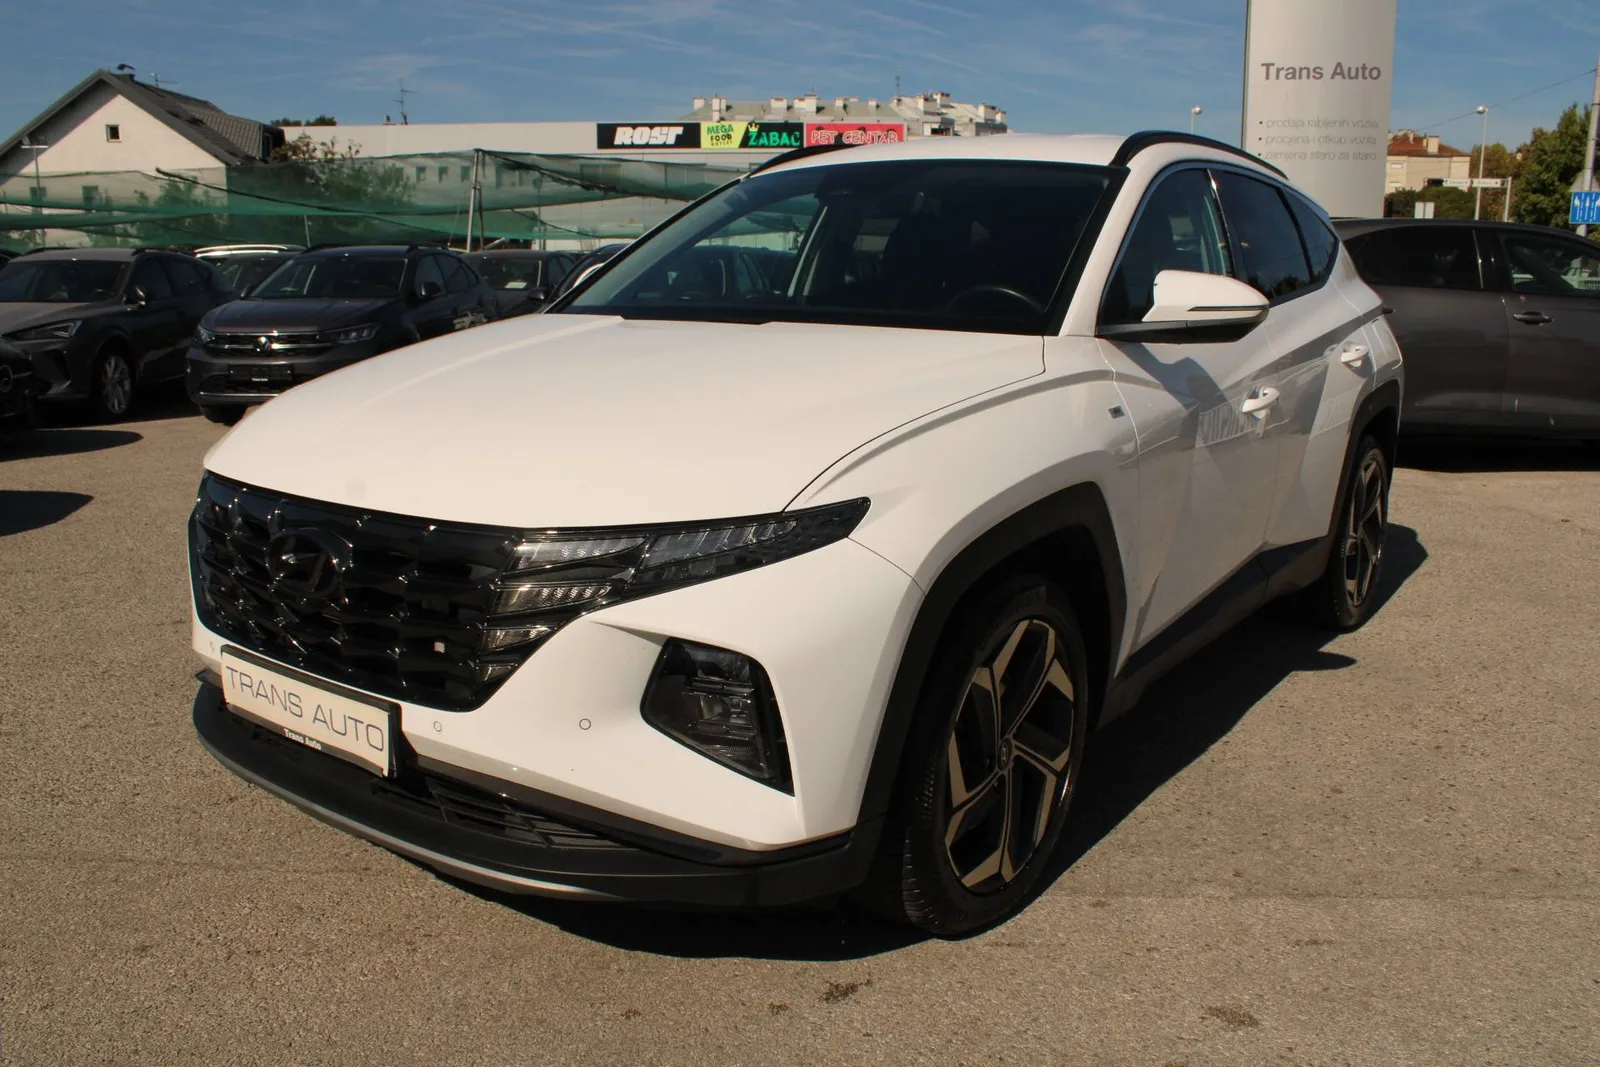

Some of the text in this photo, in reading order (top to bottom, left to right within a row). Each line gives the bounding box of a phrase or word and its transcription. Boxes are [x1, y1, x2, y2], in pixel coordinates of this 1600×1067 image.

[1261, 62, 1381, 80] Trans Auto
[706, 124, 734, 135] MEGA
[1266, 118, 1305, 129] prodaja
[614, 126, 684, 146] ROST
[710, 133, 732, 142] FOOD
[811, 130, 899, 145] PET CENTAR
[1318, 135, 1347, 146] otkup
[226, 665, 385, 752] TRANS AUTO
[283, 728, 305, 744] Trans
